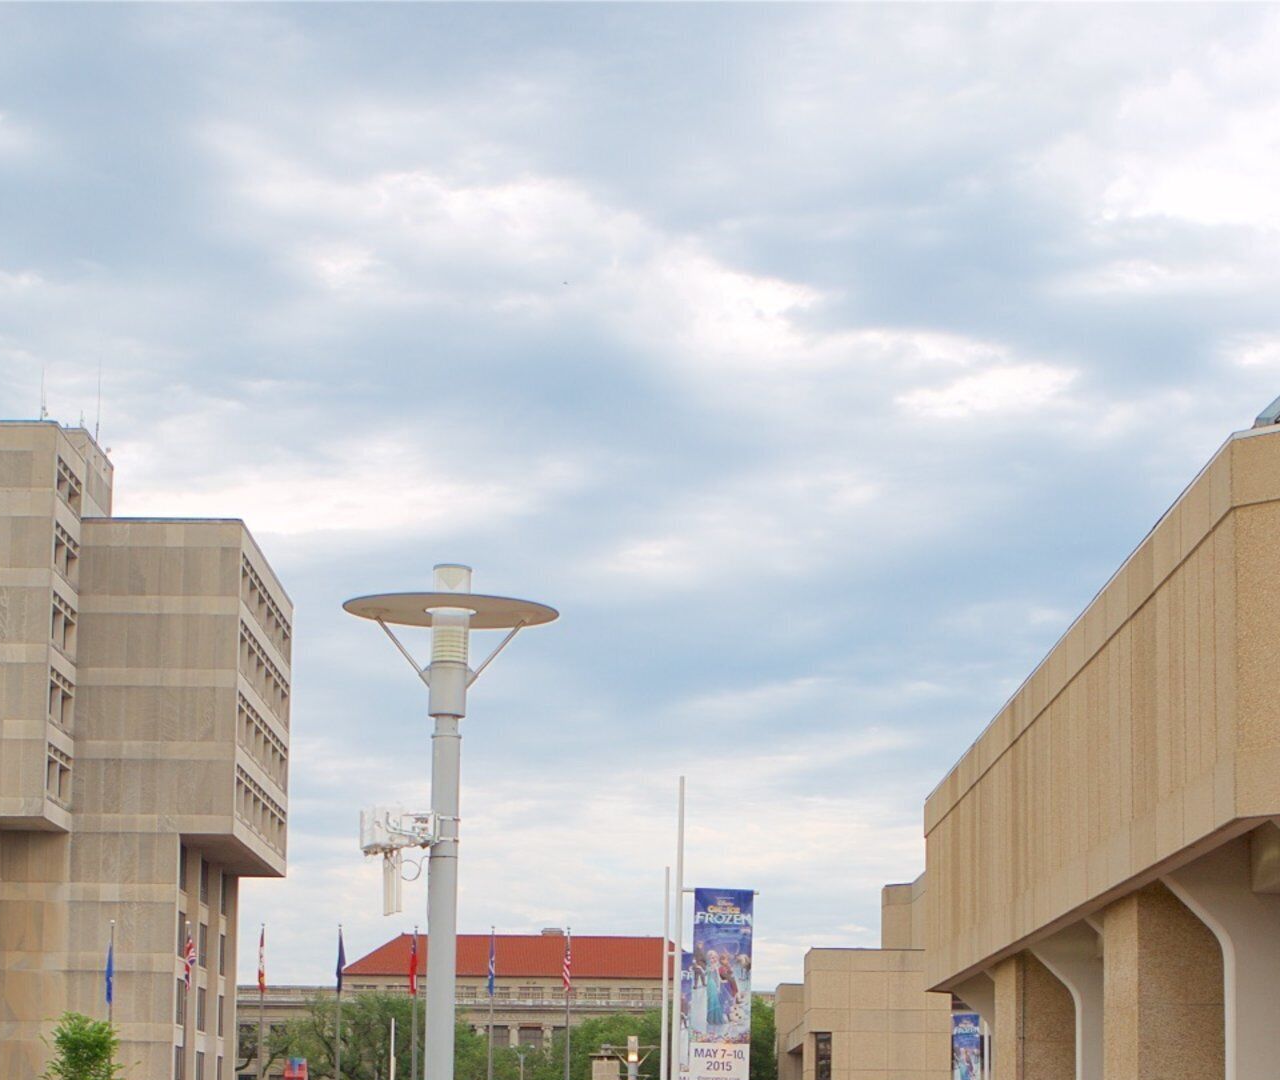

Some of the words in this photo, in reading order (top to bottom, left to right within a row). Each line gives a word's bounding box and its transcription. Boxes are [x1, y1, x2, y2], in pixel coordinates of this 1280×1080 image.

[694, 911, 753, 925] FROZEN
[694, 1048, 718, 1058] MAY
[706, 1061, 732, 1071] 2015
